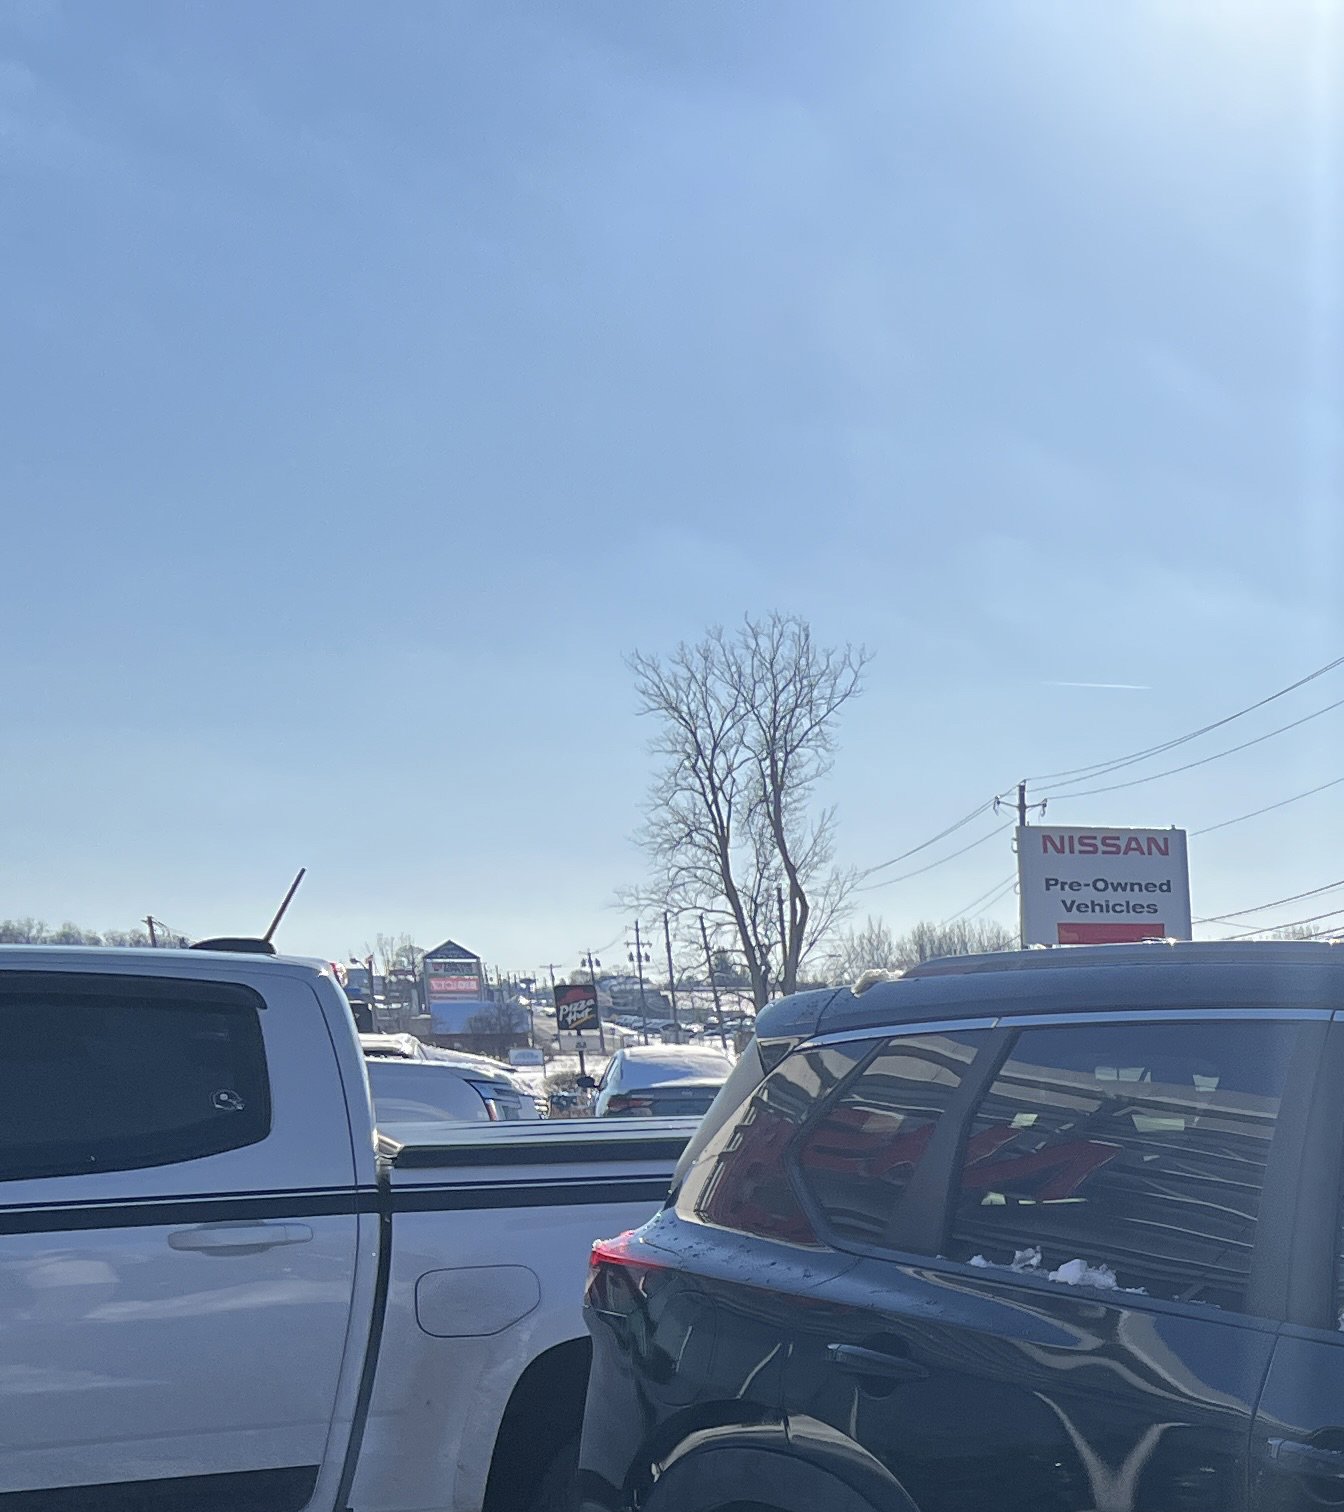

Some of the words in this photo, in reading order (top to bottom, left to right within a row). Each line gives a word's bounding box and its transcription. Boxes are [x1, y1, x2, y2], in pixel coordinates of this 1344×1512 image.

[1042, 834, 1170, 857] NISSAN
[1044, 877, 1172, 893] Pre-Owned
[1061, 899, 1159, 914] Vehicles
[559, 999, 595, 1021] Pizza
[566, 1007, 593, 1026] Hut
